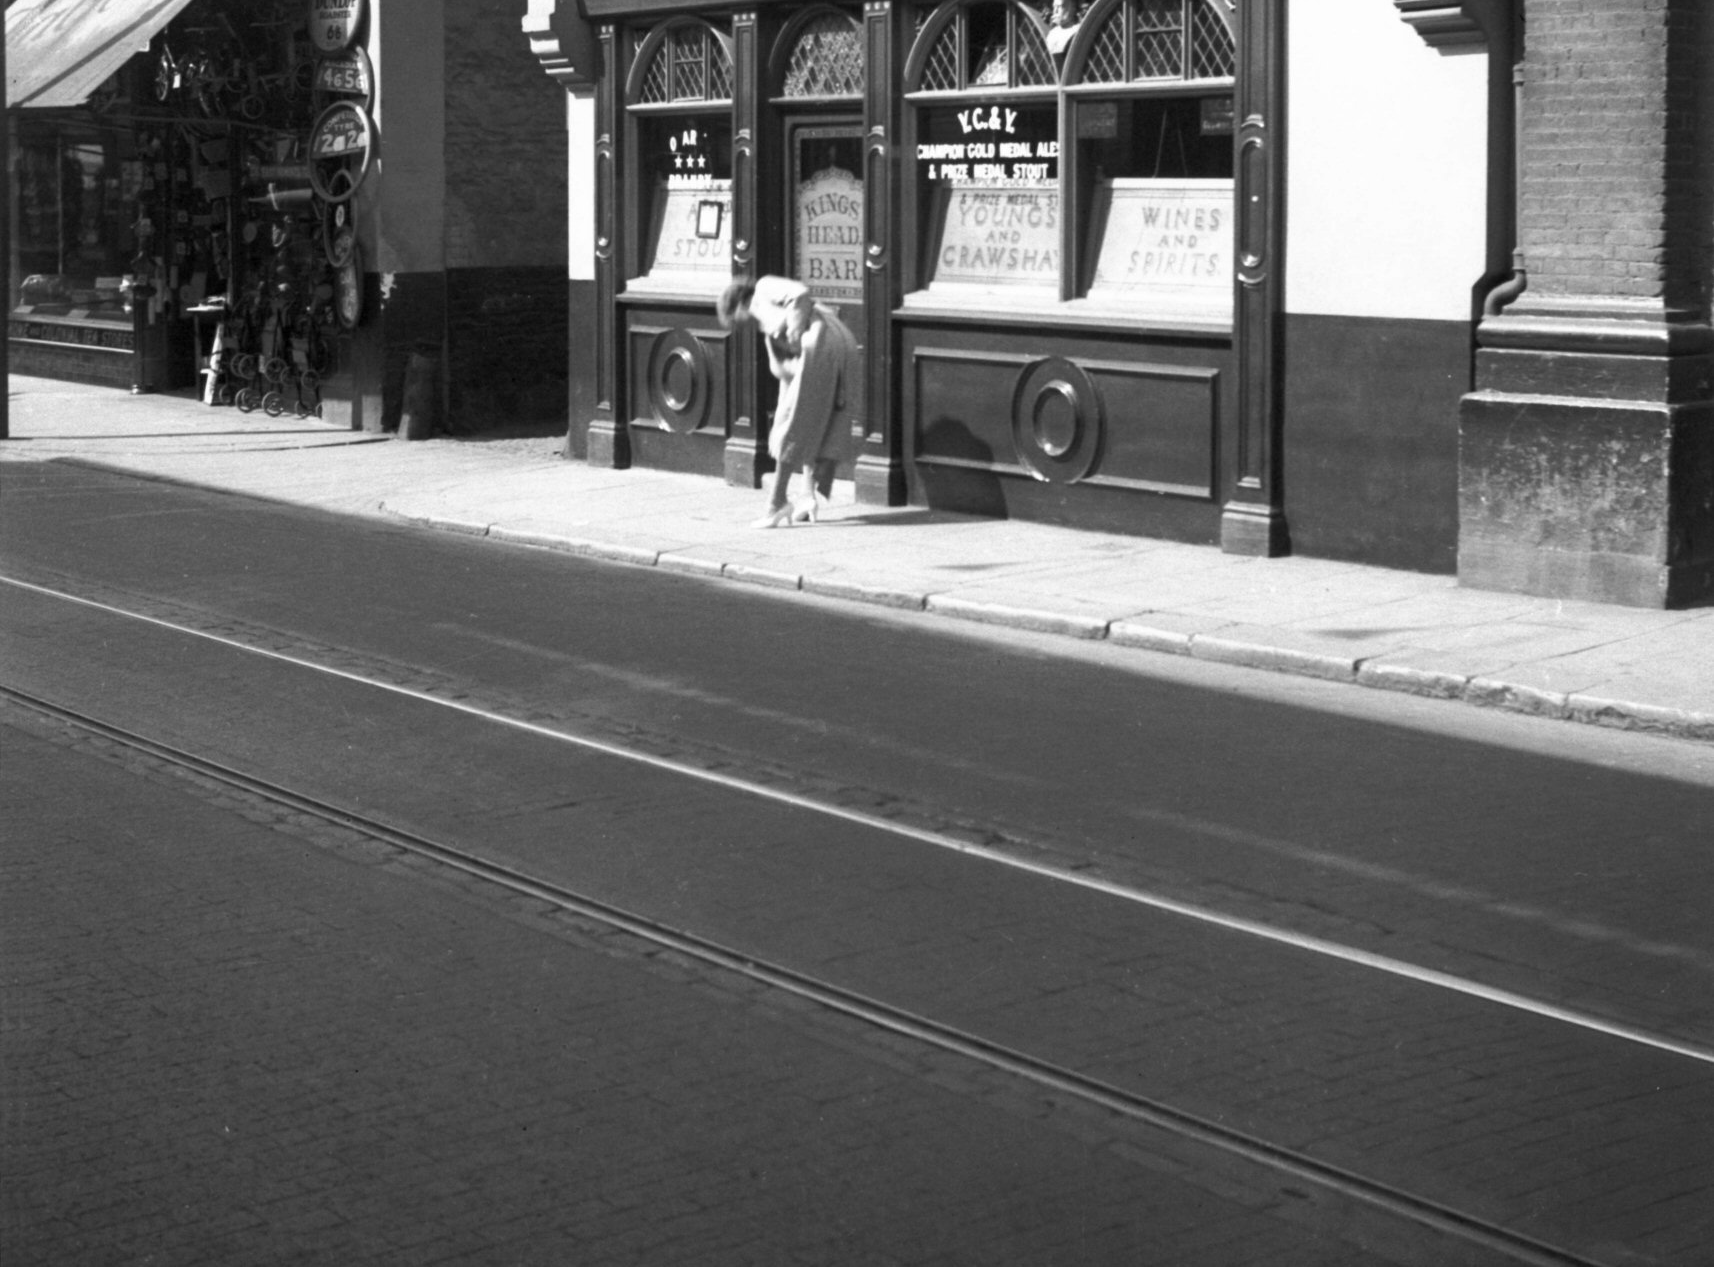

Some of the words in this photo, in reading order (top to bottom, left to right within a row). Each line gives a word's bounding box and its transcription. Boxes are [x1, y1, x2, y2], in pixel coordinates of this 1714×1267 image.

[917, 144, 965, 160] CHAMPION
[967, 143, 996, 159] GOLD
[1000, 142, 1033, 158] MEDAL
[928, 164, 937, 180] &
[941, 164, 969, 180] PRIZE
[974, 164, 1008, 180] MEDAL
[1012, 163, 1049, 180] STOUT
[804, 192, 862, 222] KINGS
[959, 205, 1057, 228] YOUNGS
[1142, 207, 1221, 232] WINES
[985, 231, 1021, 245] AND
[1157, 234, 1198, 249] AND
[673, 238, 732, 258] STOU
